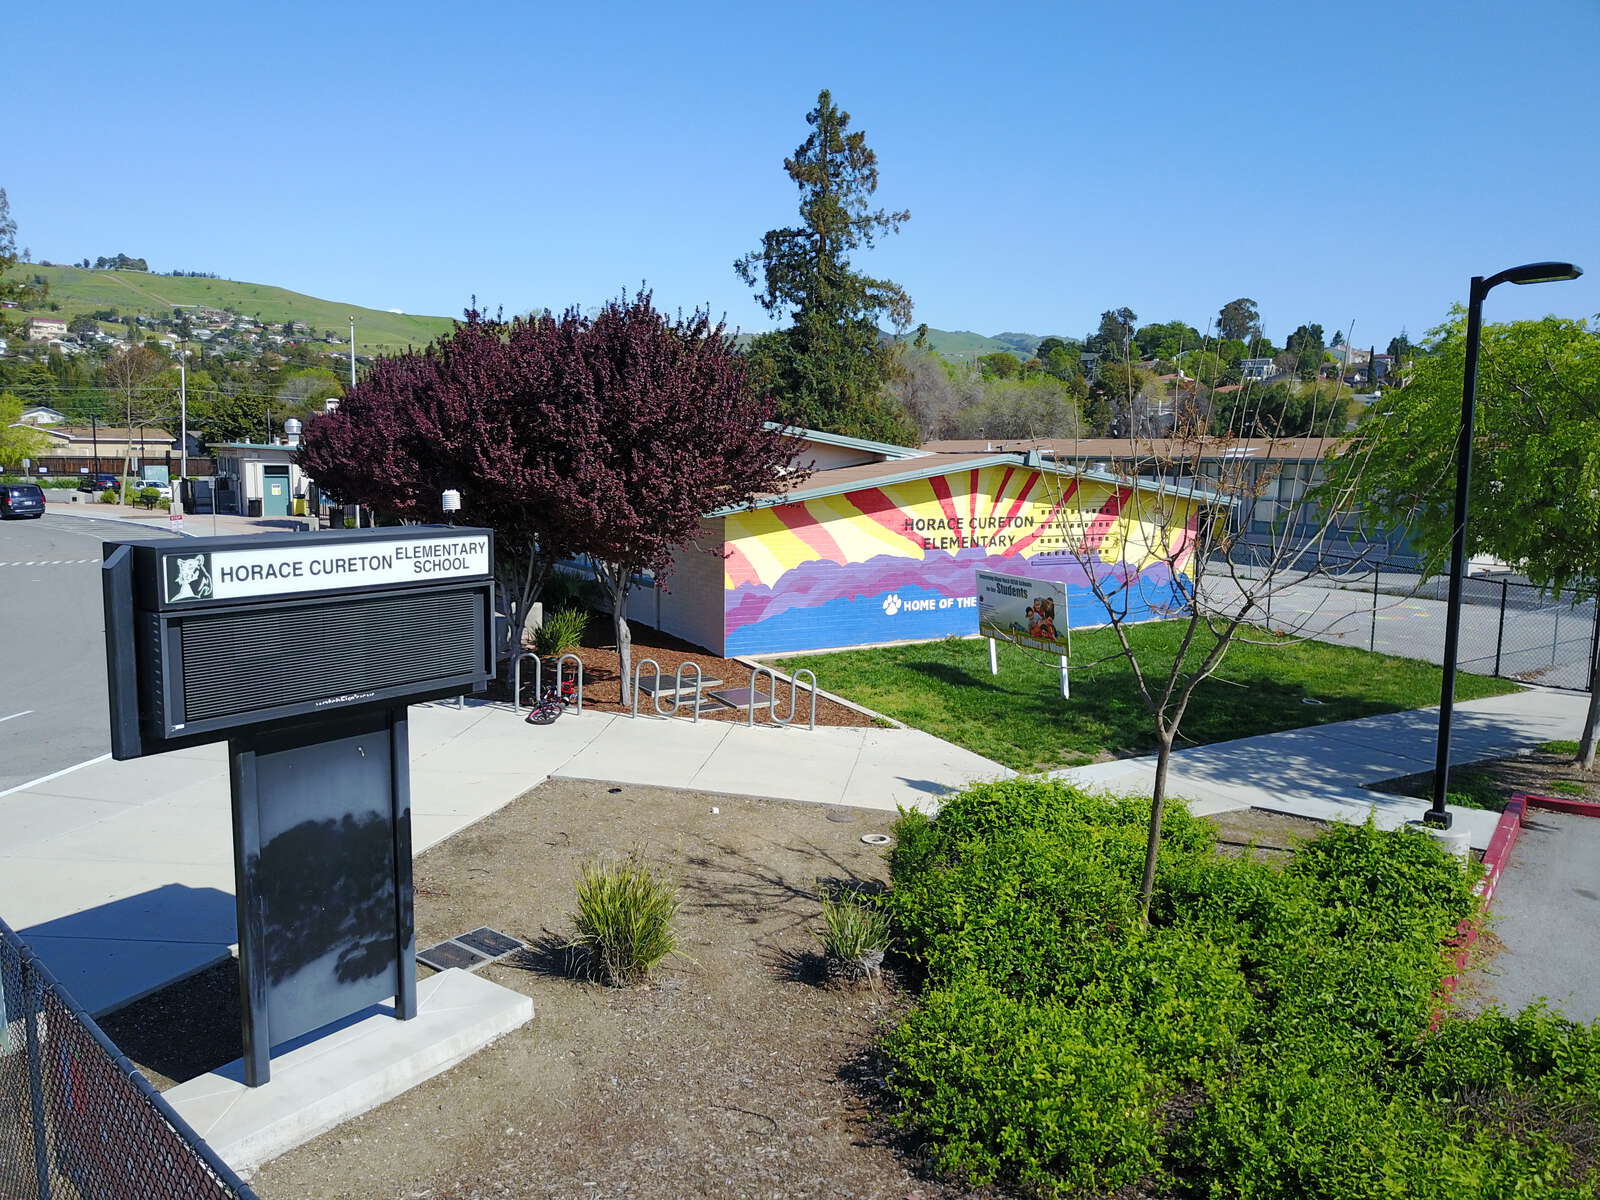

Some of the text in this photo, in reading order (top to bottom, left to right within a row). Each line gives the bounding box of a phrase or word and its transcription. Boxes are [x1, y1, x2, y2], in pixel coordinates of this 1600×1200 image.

[904, 516, 1034, 531] HORACE CURETON
[396, 541, 486, 560] ELEMENTARY
[923, 535, 1015, 550] ELEMENTARY
[220, 555, 393, 583] HORACE CURETON
[413, 557, 470, 574] SCHOOL
[997, 583, 1028, 599] Students
[903, 596, 977, 612] HOME OF THE
